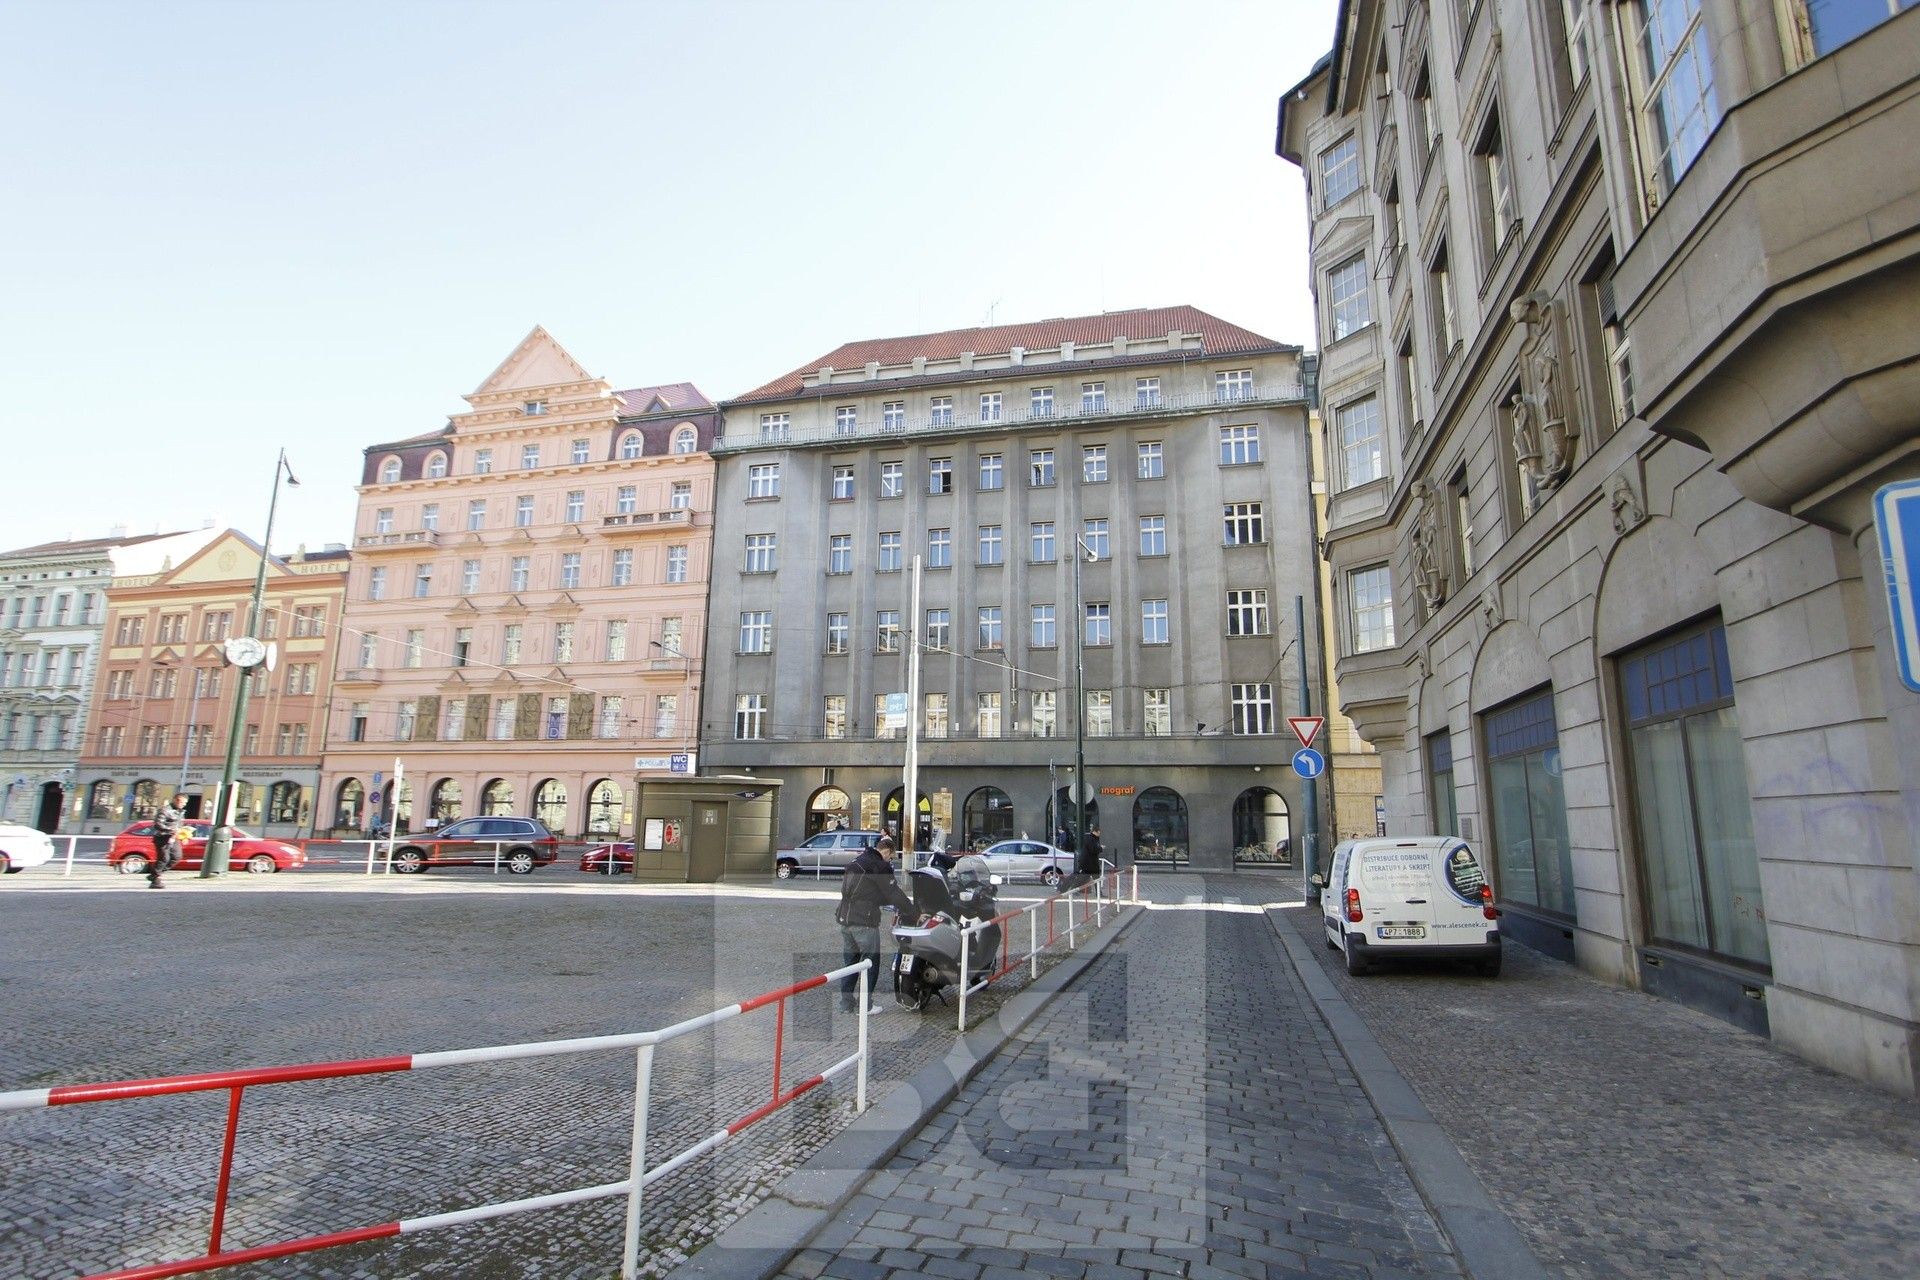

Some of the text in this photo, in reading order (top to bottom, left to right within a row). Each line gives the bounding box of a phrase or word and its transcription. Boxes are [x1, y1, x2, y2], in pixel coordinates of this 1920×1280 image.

[672, 755, 687, 763] WC
[1363, 854, 1399, 863] DISTRIBUCE
[1365, 864, 1400, 872] LITERATURY
[1408, 863, 1431, 871] SKRIPT
[1431, 922, 1488, 930] www.alescenek.cz
[1384, 928, 1397, 936] 4P7
